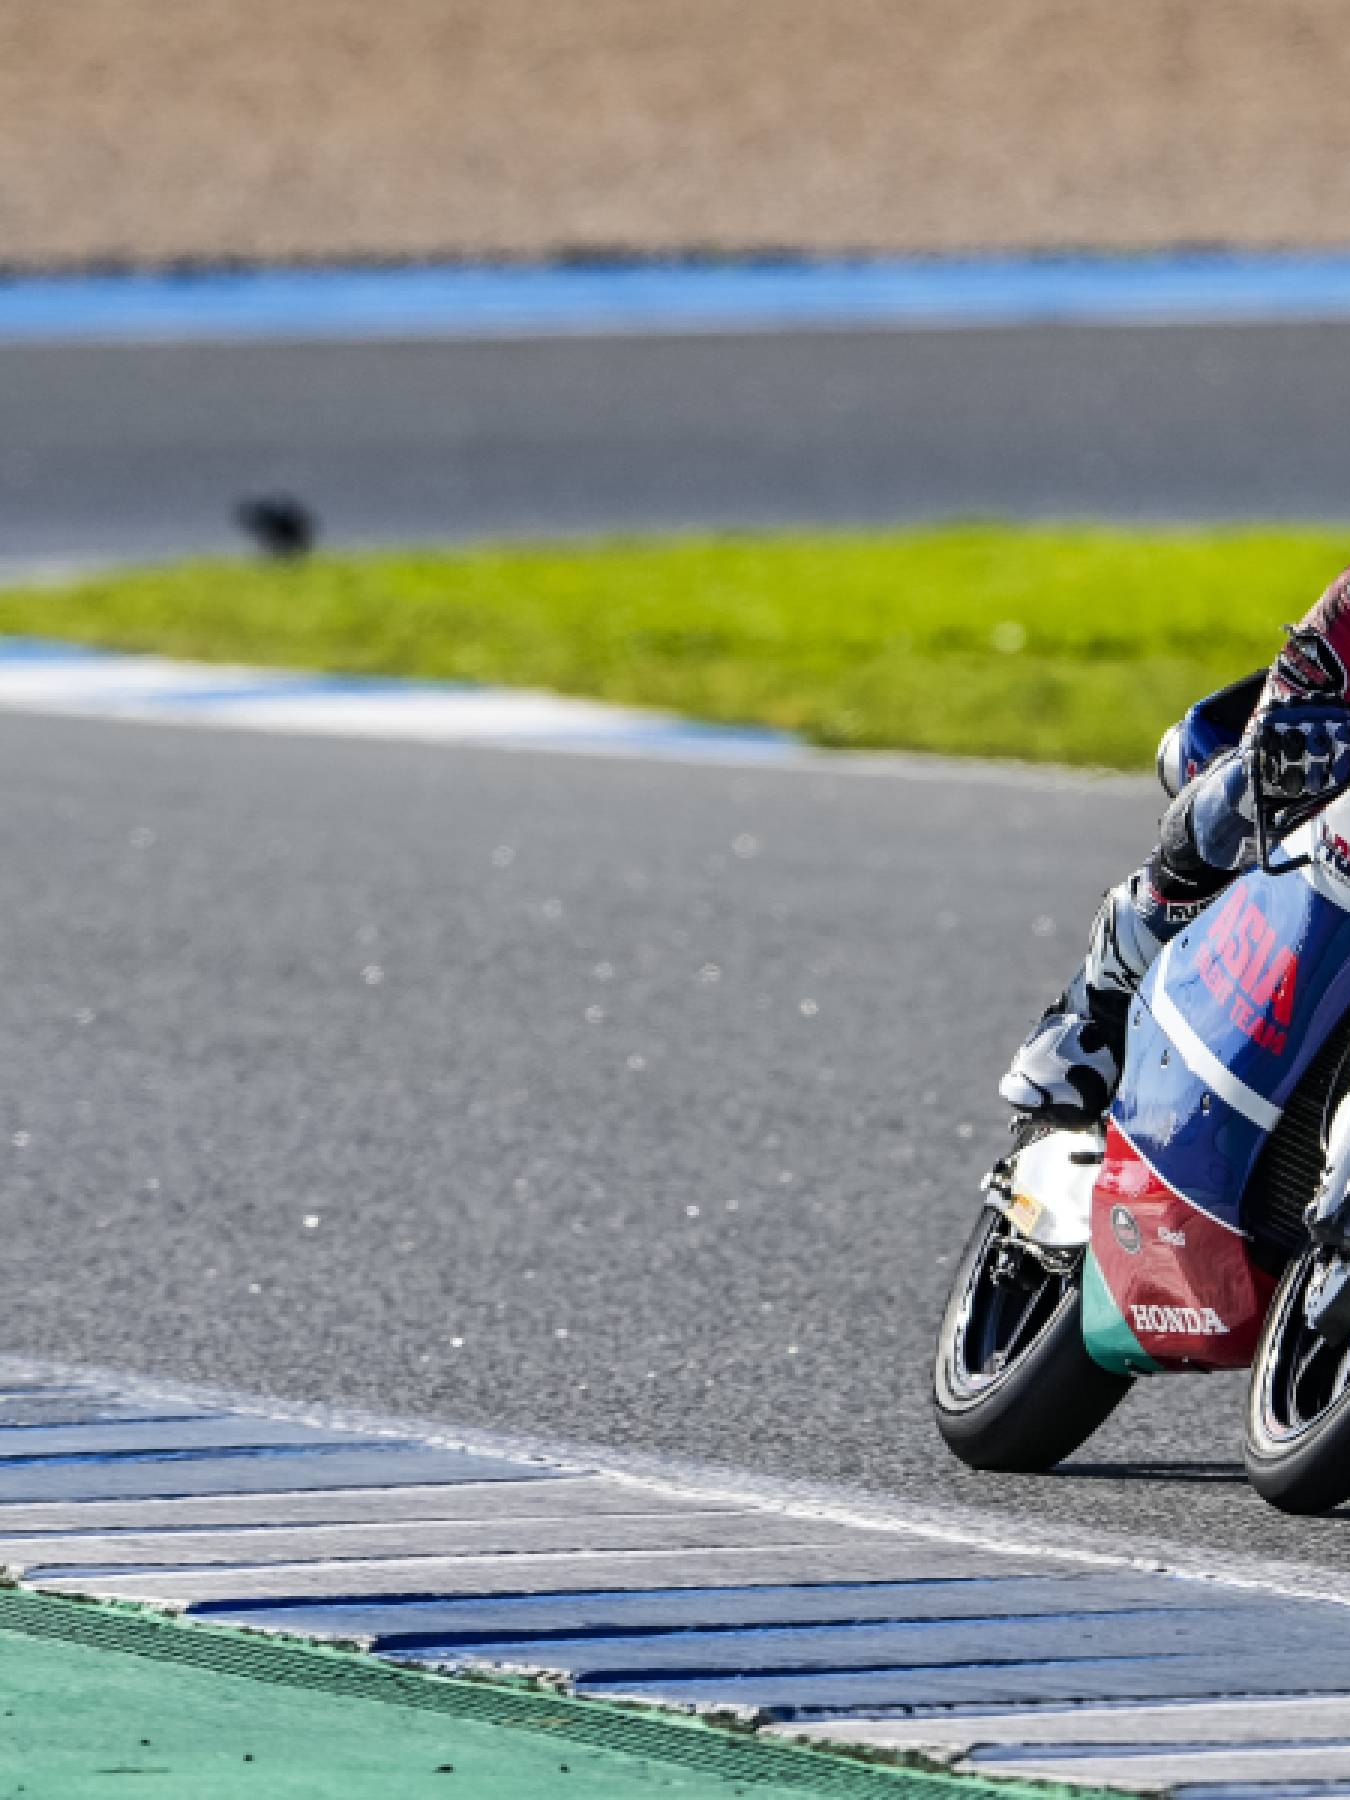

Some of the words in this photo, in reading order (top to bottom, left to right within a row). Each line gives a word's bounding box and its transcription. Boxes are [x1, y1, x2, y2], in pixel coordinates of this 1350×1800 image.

[1208, 881, 1299, 1027] ASIA
[1230, 993, 1288, 1056] TEAM
[1129, 1304, 1231, 1334] HONDA
